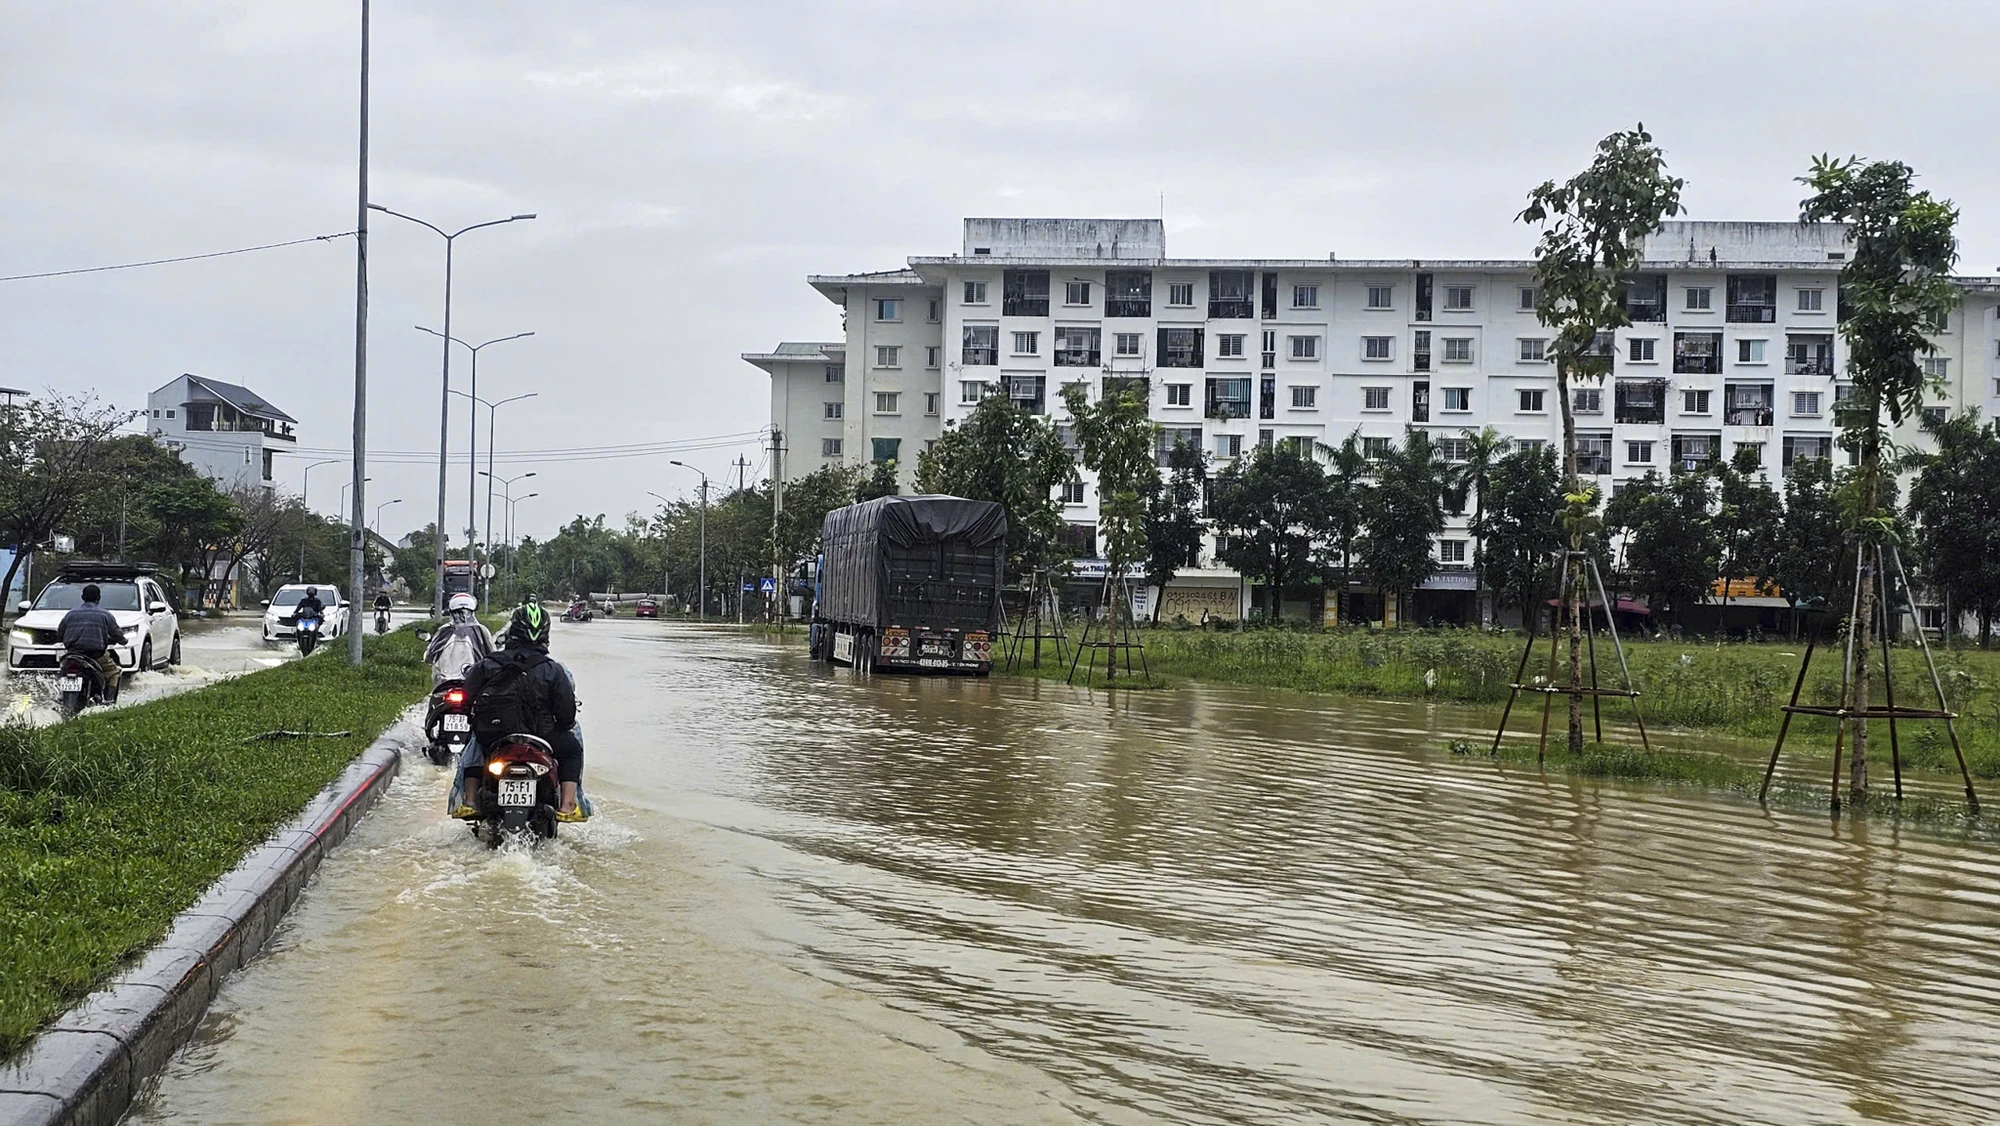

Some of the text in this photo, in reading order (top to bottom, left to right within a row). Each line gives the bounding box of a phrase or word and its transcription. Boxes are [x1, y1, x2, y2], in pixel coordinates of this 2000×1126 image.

[1442, 575, 1469, 583] TATTOO
[504, 781, 530, 793] 75-F1
[501, 793, 533, 805] 120.51
